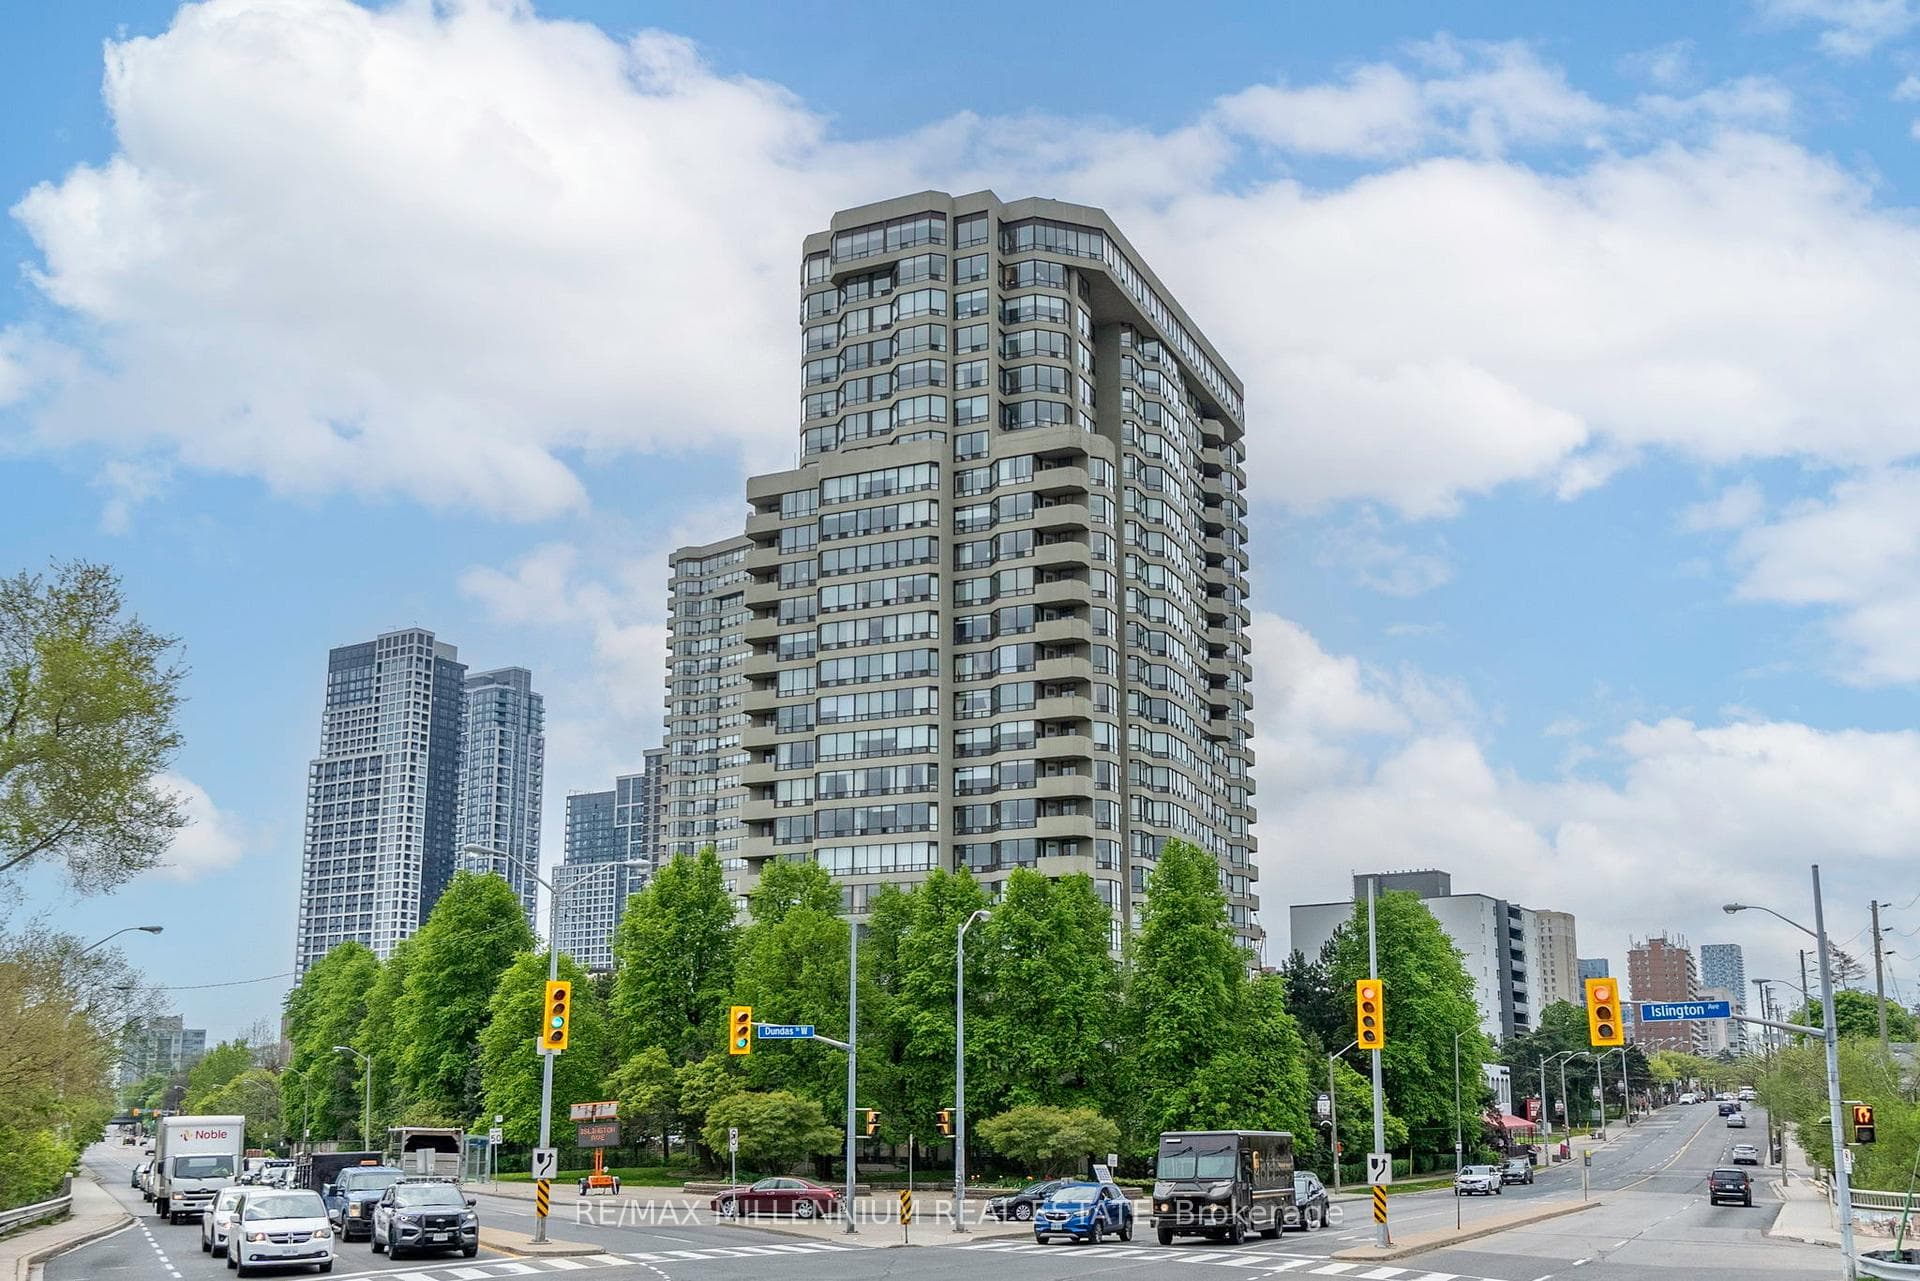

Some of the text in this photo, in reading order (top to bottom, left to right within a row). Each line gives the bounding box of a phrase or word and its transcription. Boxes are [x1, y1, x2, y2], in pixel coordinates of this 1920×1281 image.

[1651, 1005, 1705, 1019] Islington
[765, 1027, 794, 1036] Dundas
[800, 1026, 808, 1035] W
[195, 1130, 228, 1139] Noble
[491, 1134, 501, 1142] 50
